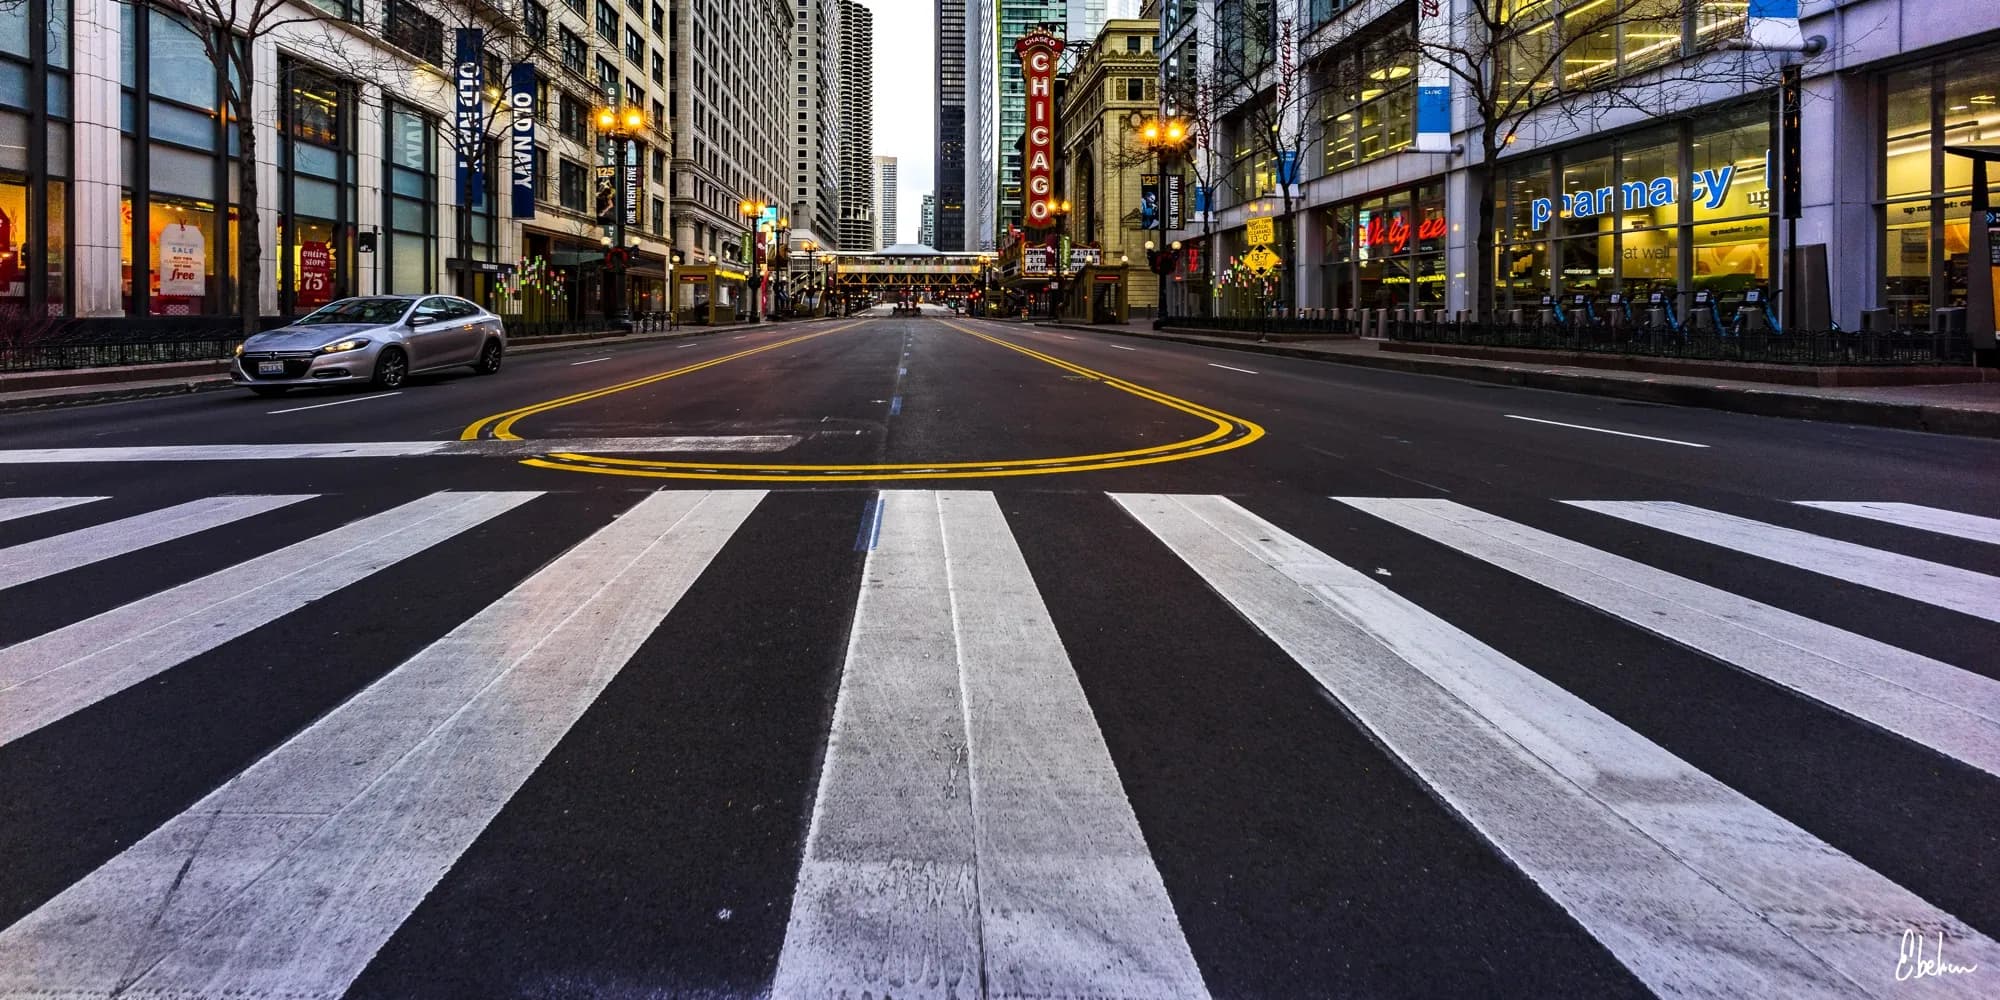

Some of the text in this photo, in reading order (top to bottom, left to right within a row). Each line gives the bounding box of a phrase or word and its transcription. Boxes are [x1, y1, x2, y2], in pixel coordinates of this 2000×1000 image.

[1025, 36, 1049, 46] CHASE
[459, 61, 480, 106] OLD
[513, 92, 532, 189] OLD NAVY
[1031, 52, 1049, 219] CHICAGO
[596, 167, 615, 176] 125
[1142, 176, 1158, 184] 125
[626, 166, 637, 224] ONE TWENTY FIVE
[1169, 176, 1179, 229] ONE TWENTY FIVE
[1917, 200, 1957, 212] maet:
[172, 246, 194, 254] SALE
[303, 249, 328, 259] entire
[1642, 245, 1670, 260] well
[305, 258, 326, 267] store
[169, 268, 195, 281] free
